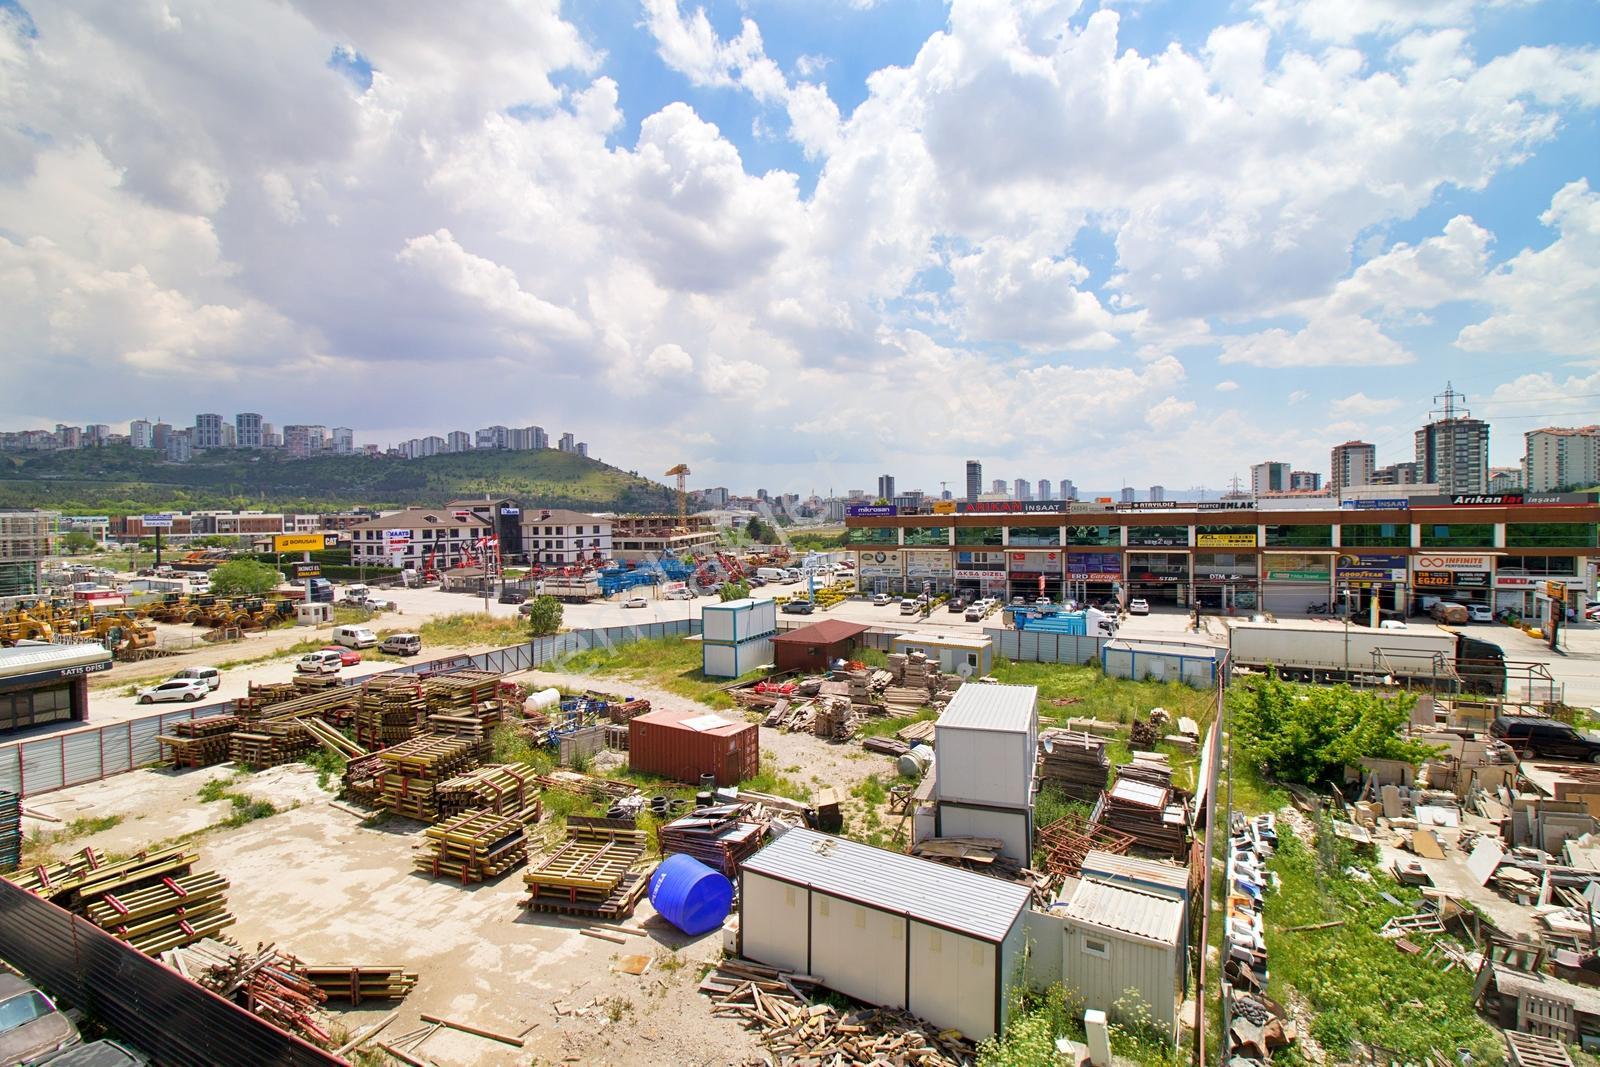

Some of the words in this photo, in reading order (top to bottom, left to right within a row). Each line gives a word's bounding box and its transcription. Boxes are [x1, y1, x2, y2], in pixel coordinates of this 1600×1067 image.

[965, 501, 1022, 511] ARIKAN
[325, 537, 337, 546] CAT
[1339, 570, 1384, 578] GOODYEAR
[1418, 577, 1449, 585] EGZOZ
